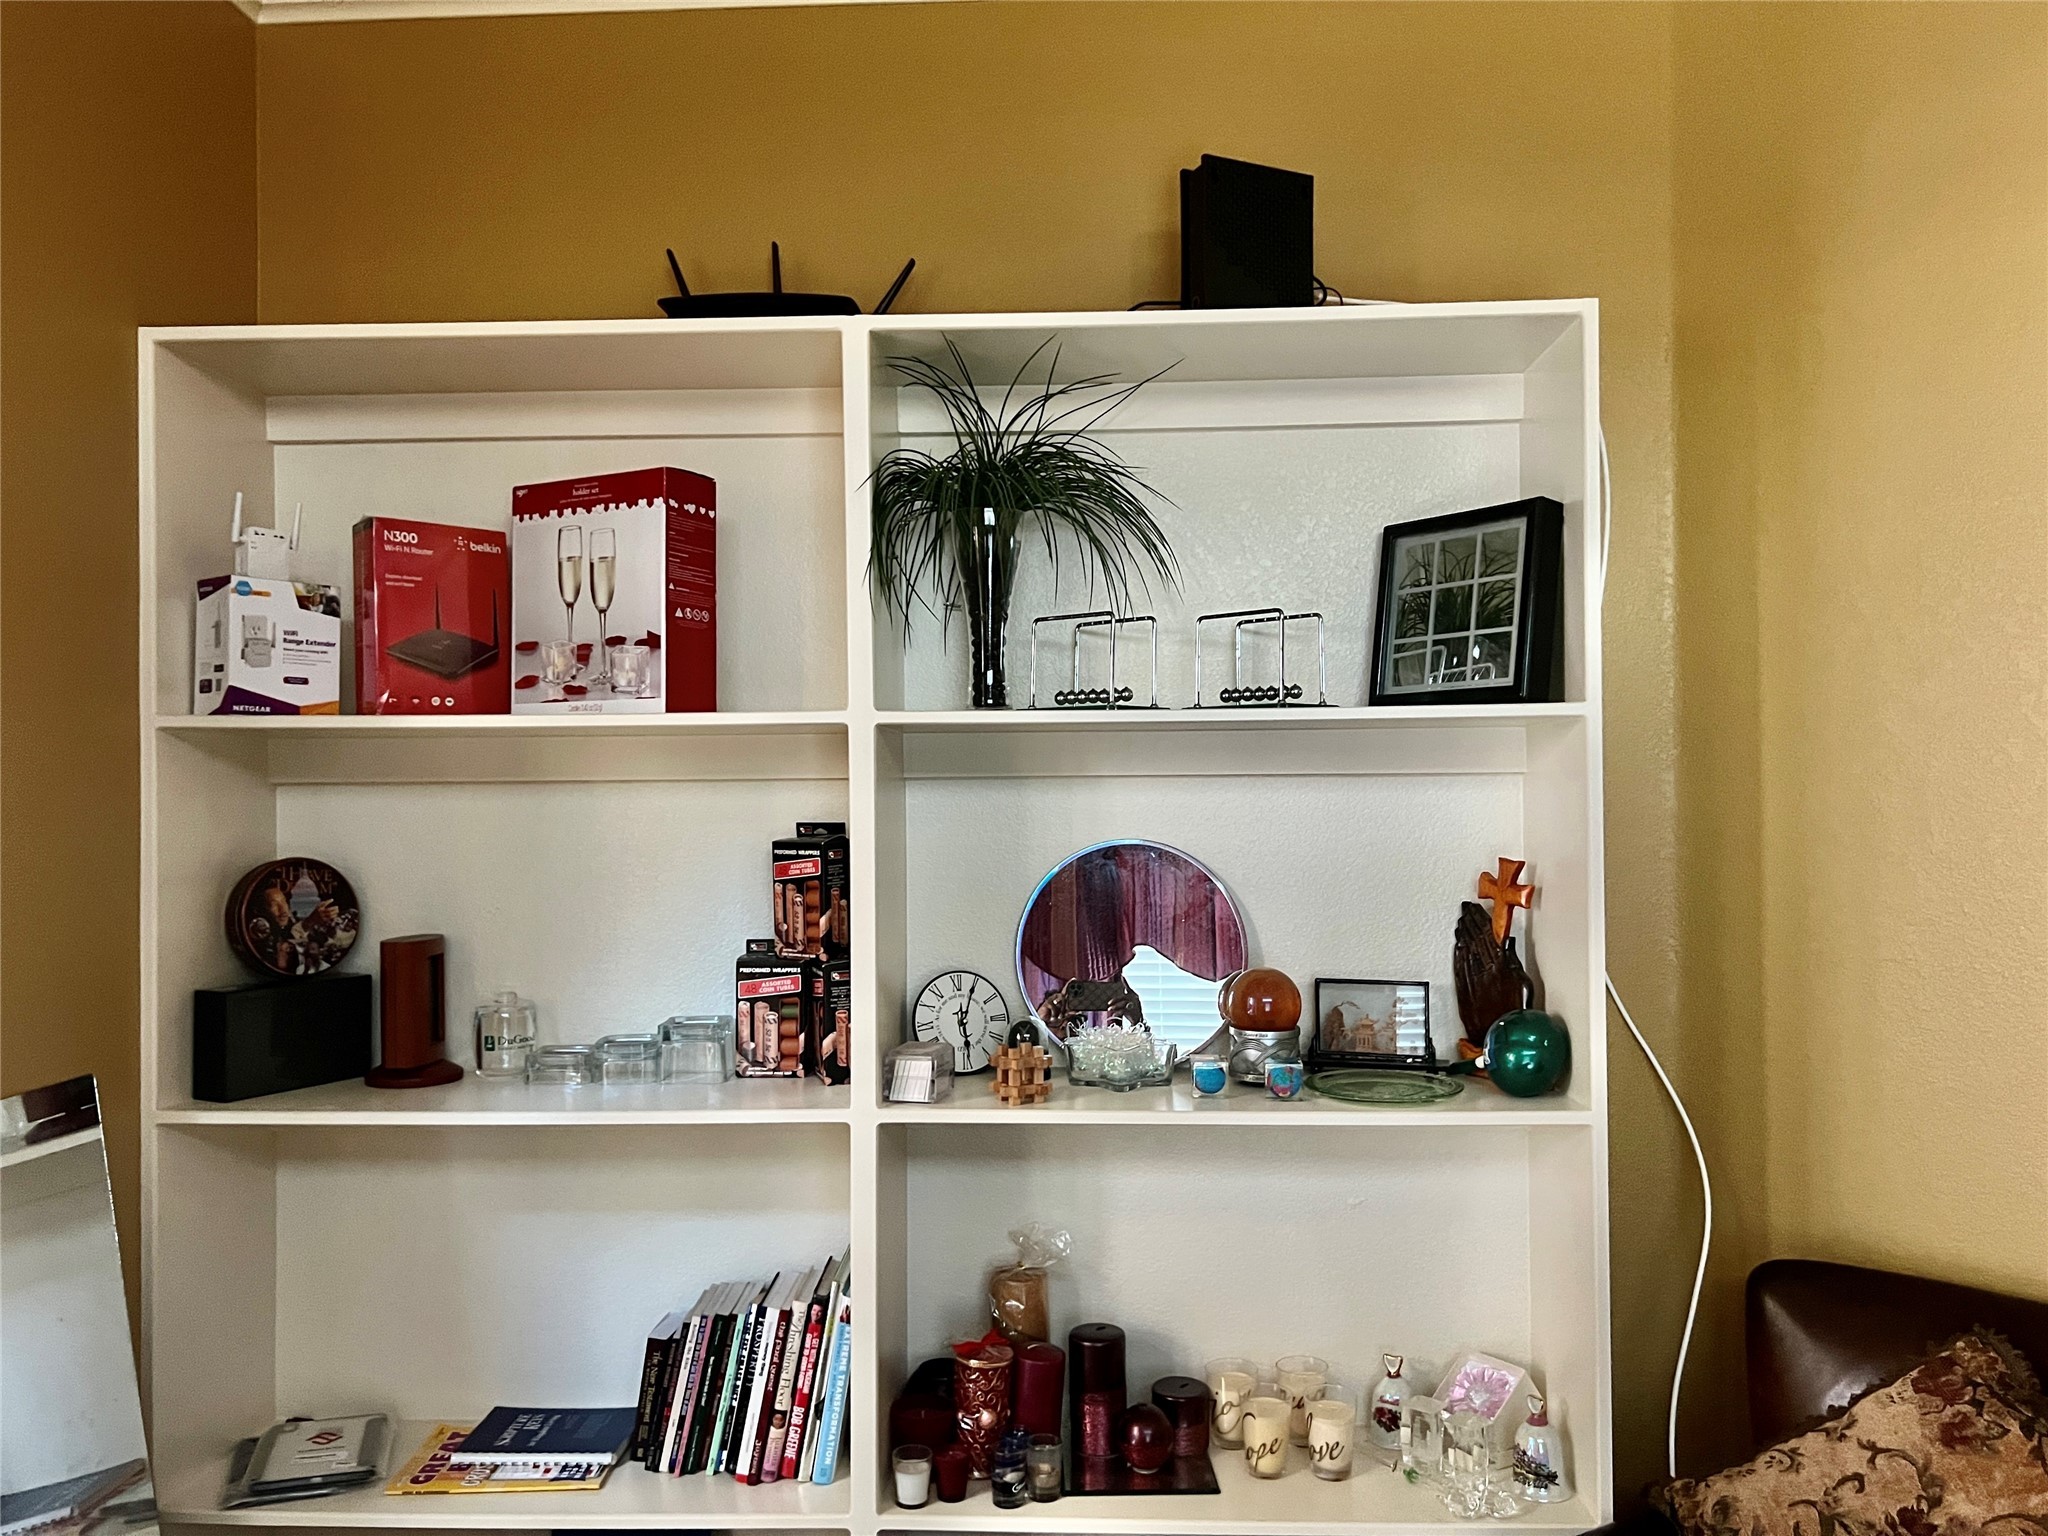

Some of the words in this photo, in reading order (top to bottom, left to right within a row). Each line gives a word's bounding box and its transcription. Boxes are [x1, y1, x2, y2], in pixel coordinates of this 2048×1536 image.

[384, 530, 418, 543] N300
[470, 542, 501, 554] belkin
[283, 638, 304, 646] Range
[305, 639, 336, 647] Extender
[745, 985, 756, 994] 48
[949, 975, 962, 991] XII
[928, 984, 944, 1001] XI
[983, 993, 998, 1005] II
[919, 1001, 935, 1012] X
[990, 1013, 1006, 1021] III
[917, 1021, 934, 1032] IX
[812, 1338, 820, 1348] GET
[840, 1326, 850, 1373] EXTREME
[653, 1351, 662, 1364] The
[746, 1318, 765, 1387] PROSPERITY
[810, 1348, 818, 1362] WITH
[649, 1368, 658, 1383] New
[802, 1369, 813, 1394] PROGRAM
[776, 1378, 791, 1406] Floor
[644, 1387, 655, 1422] Testament
[523, 1414, 545, 1430] KEYS
[791, 1406, 804, 1422] BOB
[824, 1374, 845, 1465] TRANSFORMATION
[494, 1414, 532, 1446] SCRIPTURE
[784, 1422, 801, 1460] GREENE
[409, 1431, 469, 1485] GREAT
